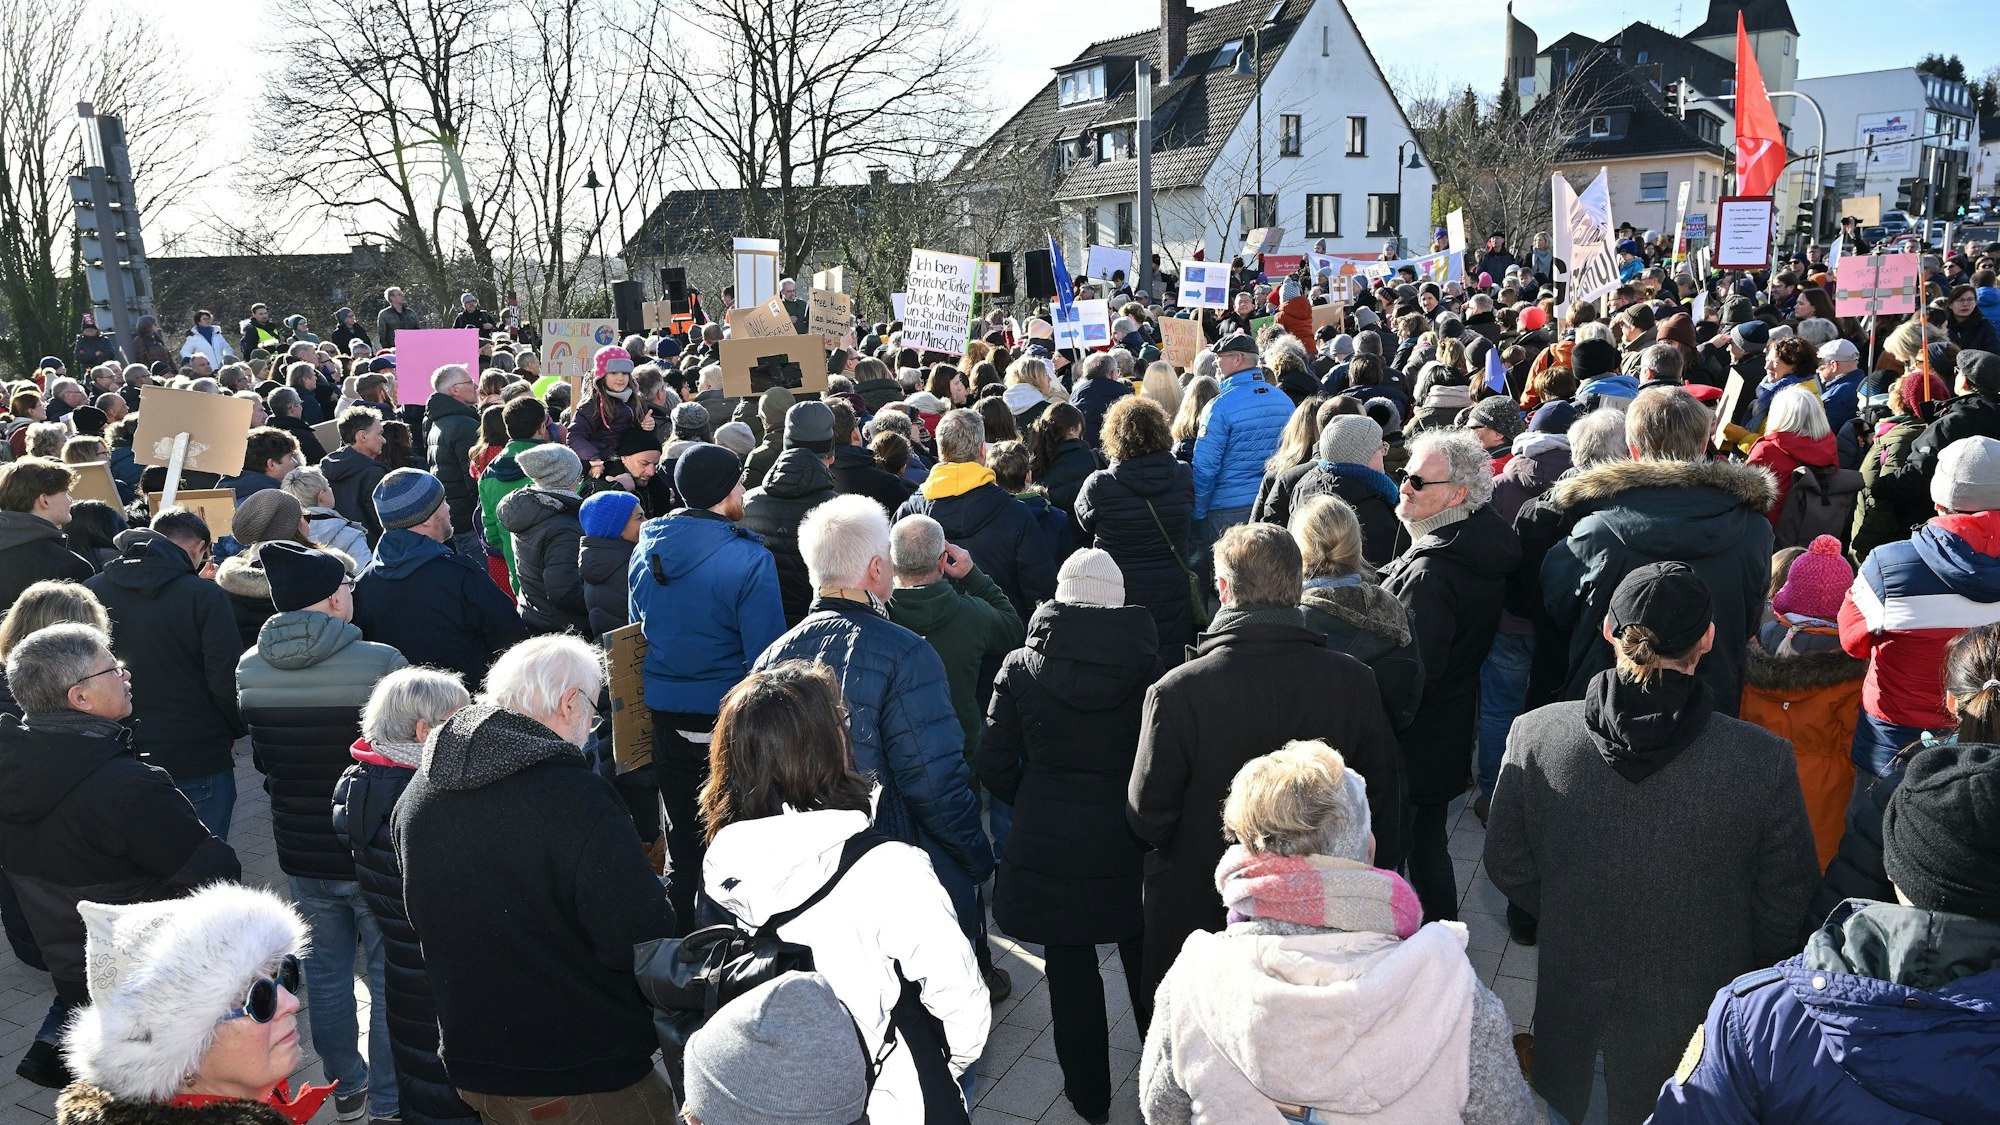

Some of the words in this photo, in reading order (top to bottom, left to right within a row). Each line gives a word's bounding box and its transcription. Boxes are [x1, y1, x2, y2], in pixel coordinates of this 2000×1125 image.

[1863, 124, 1908, 134] WASSER
[935, 259, 958, 275] ben
[908, 272, 948, 292] Grieche,
[948, 277, 972, 296] Türke,
[812, 291, 828, 308] Free
[830, 296, 847, 316] Hugs
[906, 287, 935, 308] Jude,
[936, 293, 970, 314] Moslem
[748, 312, 769, 337] NIE
[904, 316, 920, 328] mir
[906, 307, 919, 316] un
[920, 307, 970, 326] Buddhist
[548, 322, 591, 338] UNSERE
[782, 321, 792, 333] IST
[825, 328, 838, 336] nur
[903, 330, 920, 340] nur
[1164, 322, 1197, 338] MEINE
[1164, 334, 1199, 348] ZUKUN
[1166, 350, 1178, 361] IST
[548, 362, 564, 375] IST
[621, 633, 648, 676] sind
[628, 686, 652, 720] alle
[630, 728, 652, 765] Wir
